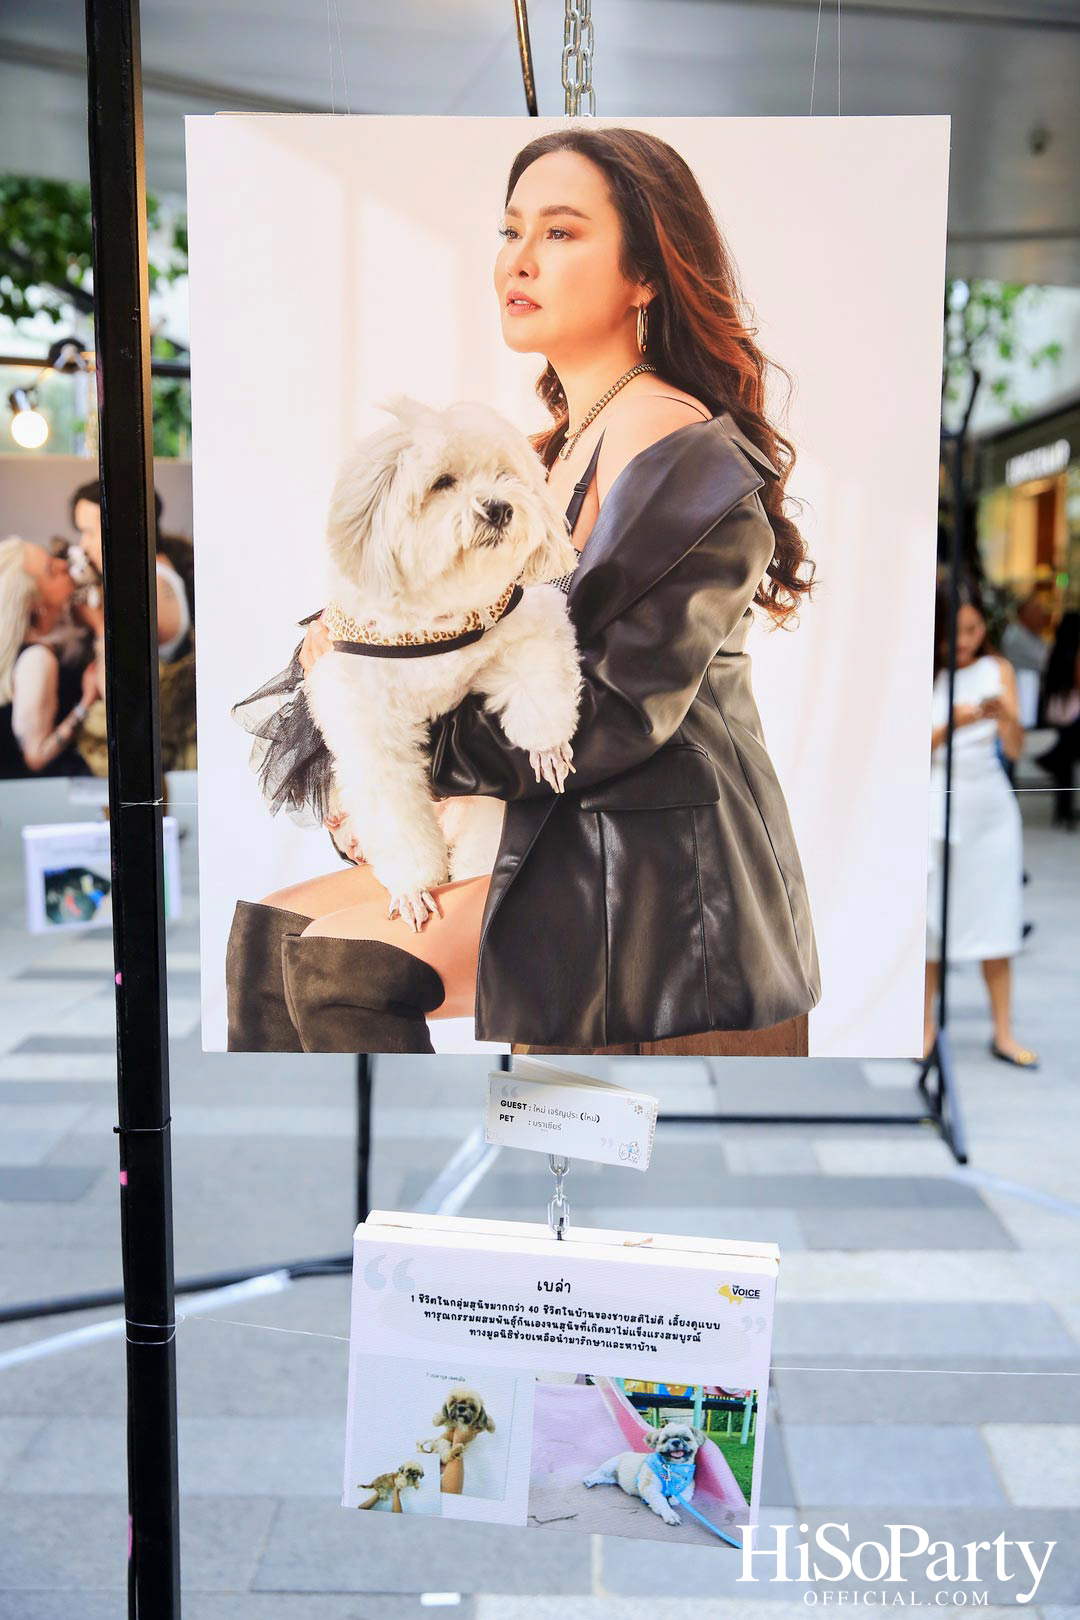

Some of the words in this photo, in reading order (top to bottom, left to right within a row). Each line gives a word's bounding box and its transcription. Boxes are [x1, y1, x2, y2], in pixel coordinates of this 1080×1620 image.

[499, 1114, 515, 1122] PET
[500, 1100, 527, 1110] GUEST
[533, 1104, 546, 1113] ใหม่
[548, 1108, 578, 1119] เจริญปุระ
[580, 1112, 600, 1123] (ใหม่)
[537, 1278, 571, 1293] เบล่า
[732, 1288, 761, 1297] VOICE
[418, 1293, 525, 1312] ชีวิตในกลุ่มสุนัขมากกว่า
[528, 1305, 539, 1313] 40
[543, 1304, 664, 1325] ชีวิตในบ้านของชายสติไม่ดี
[668, 1314, 721, 1331] เลี้ยงดูแบบ
[424, 1310, 702, 1344] ทารุณกรรมผสมพันธุ์กันเองจนสุนัขที่เกิดมาไม่แข็งแรงสมบูรณ์
[469, 1328, 658, 1353] ทางมูลนิธิช่วยเหลือนำมารักษาและหาบ้าน
